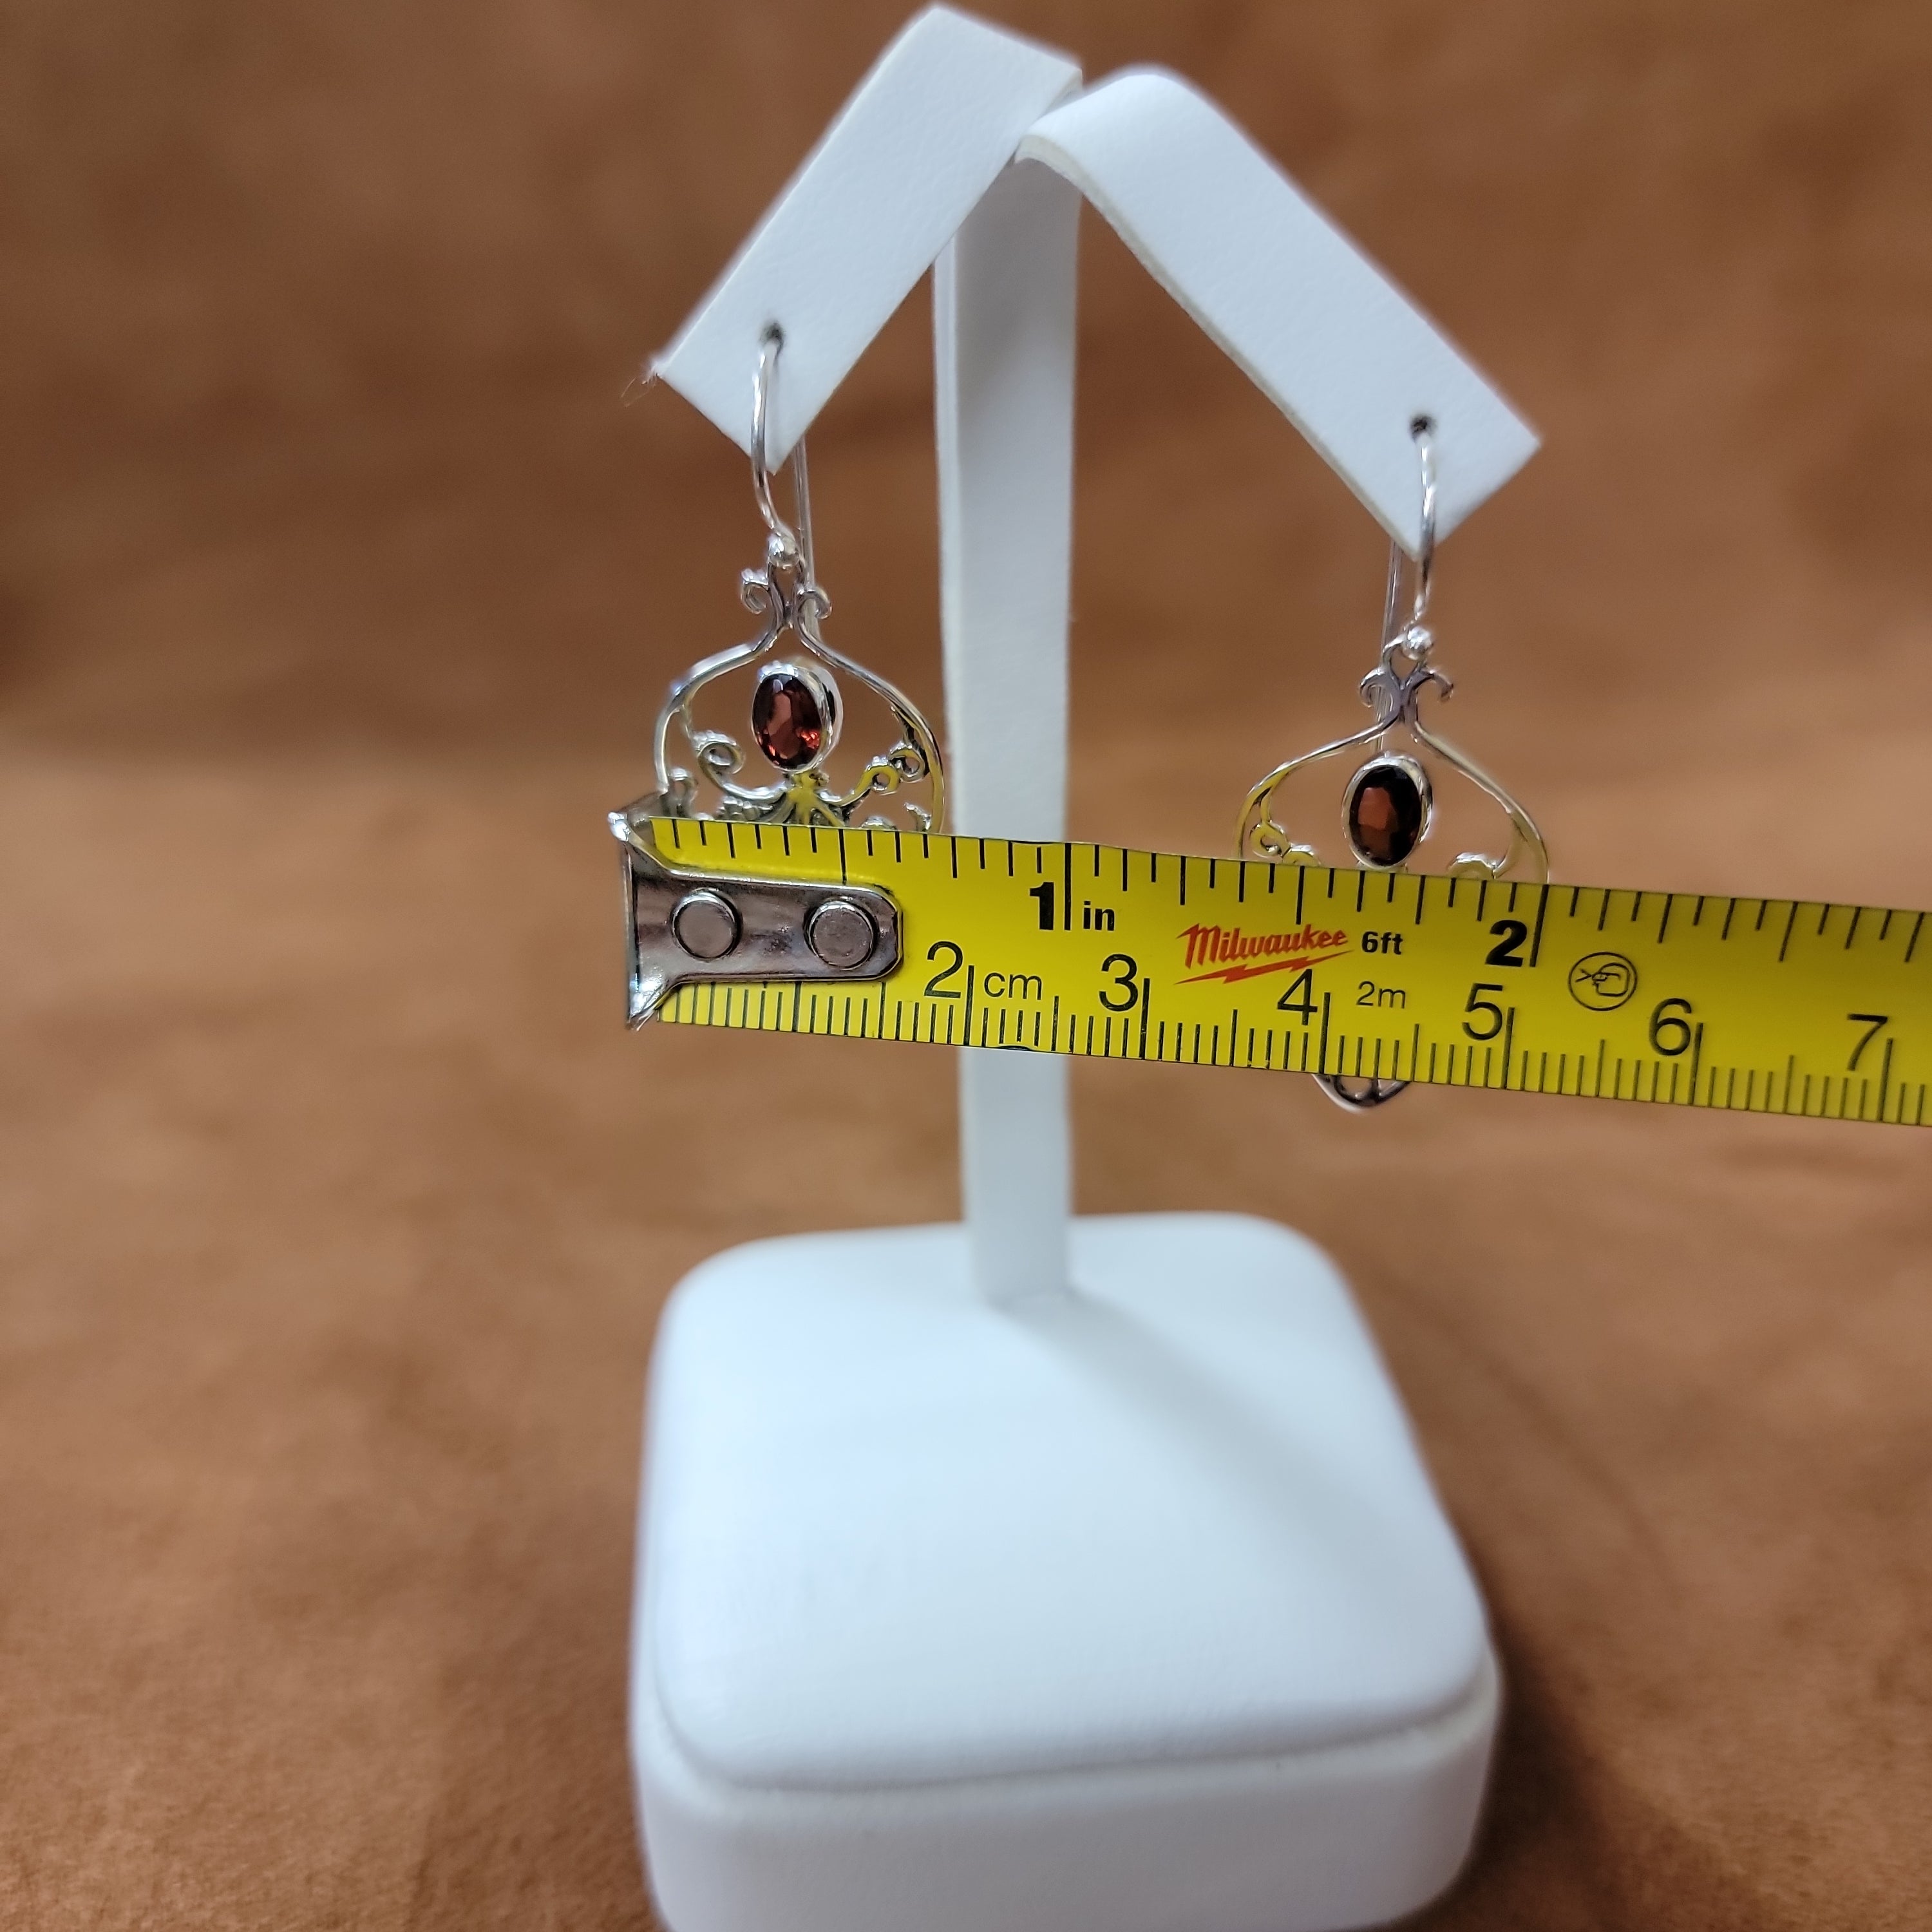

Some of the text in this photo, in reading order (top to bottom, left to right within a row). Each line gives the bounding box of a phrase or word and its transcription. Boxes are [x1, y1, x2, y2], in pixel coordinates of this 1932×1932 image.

[1030, 882, 1115, 931] 1 in
[923, 941, 1043, 1001] 2 cm
[1177, 923, 1403, 970] Milwaukee 6ft
[1484, 920, 1528, 967] 2
[1099, 954, 1138, 1012] 3
[1276, 969, 1318, 1026] 4
[1356, 981, 1406, 1009] 2m
[1461, 983, 1503, 1040] 5
[1649, 998, 1692, 1056] 6
[1847, 1013, 1888, 1071] 7
